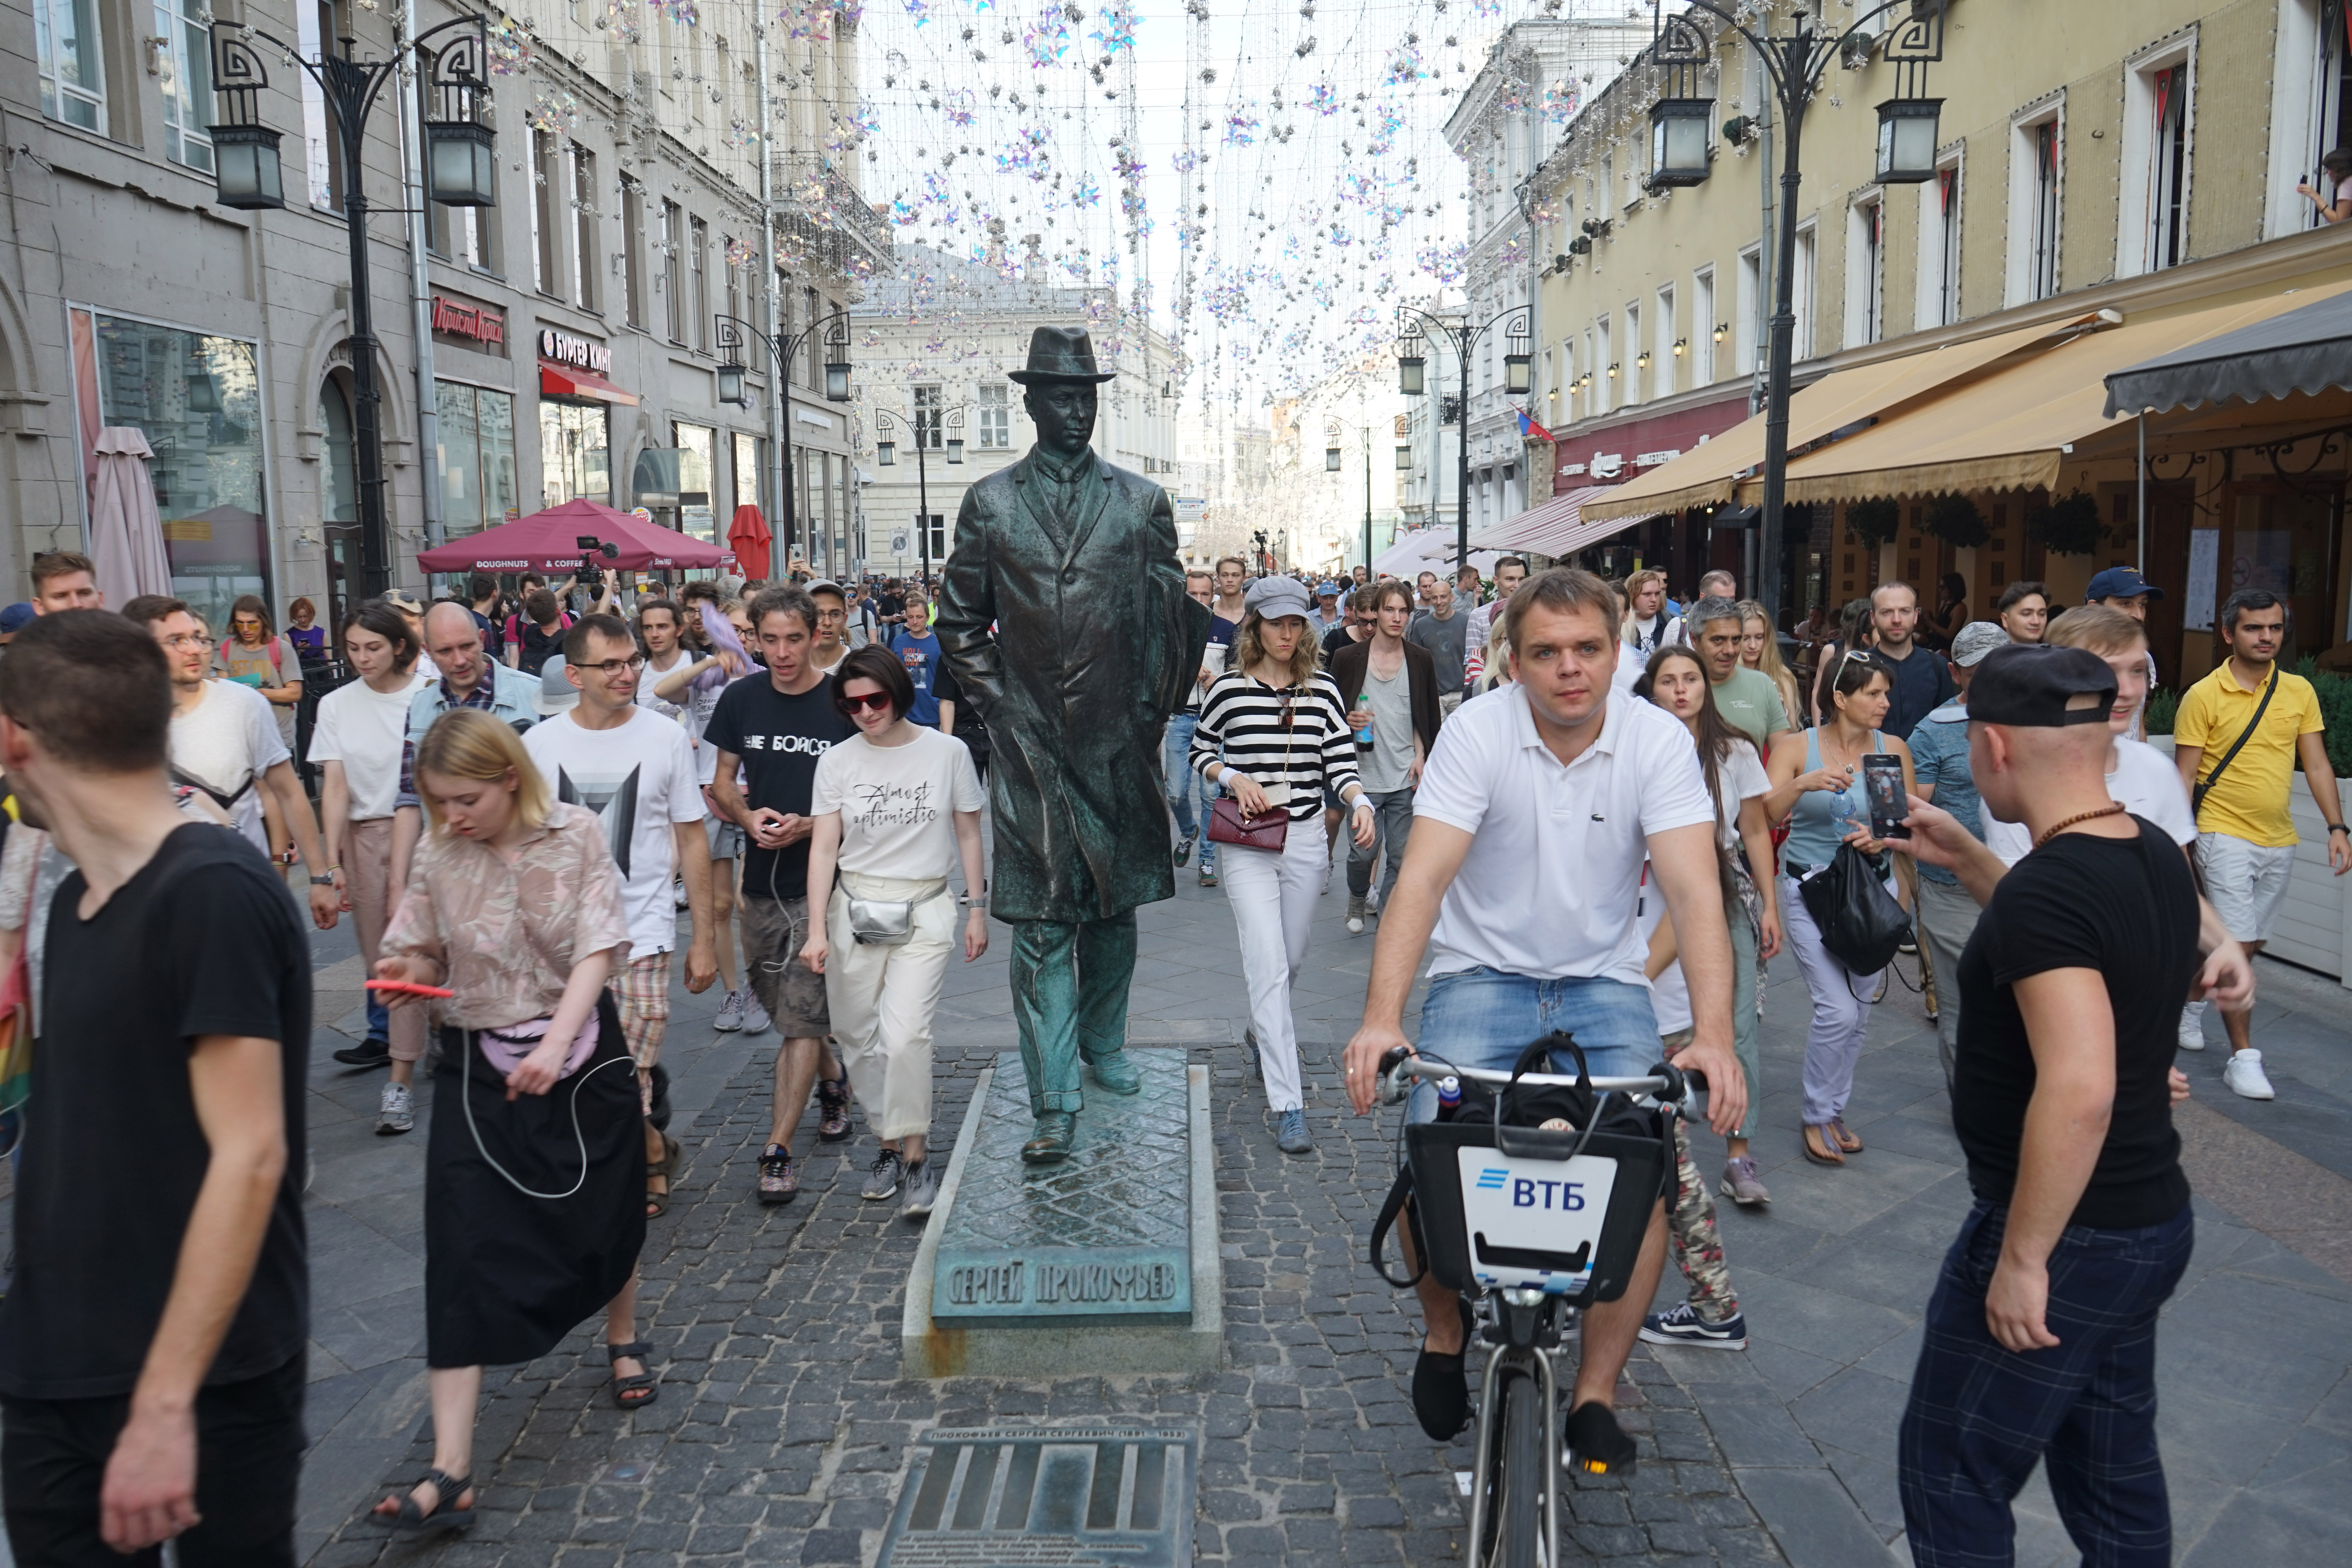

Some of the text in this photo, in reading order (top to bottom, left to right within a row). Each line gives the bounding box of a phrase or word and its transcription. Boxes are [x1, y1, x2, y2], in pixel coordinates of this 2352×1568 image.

[556, 332, 611, 373] БУРГЕР КИНГ
[905, 657, 919, 667] DAY
[772, 735, 831, 756] БОЙСЯ
[853, 780, 935, 805] Almost
[853, 798, 939, 834] optimistic
[1514, 1178, 1585, 1211] ВТБ
[947, 1259, 1176, 1304] СЕРГЕЙ ПРОКОФЬЕВ
